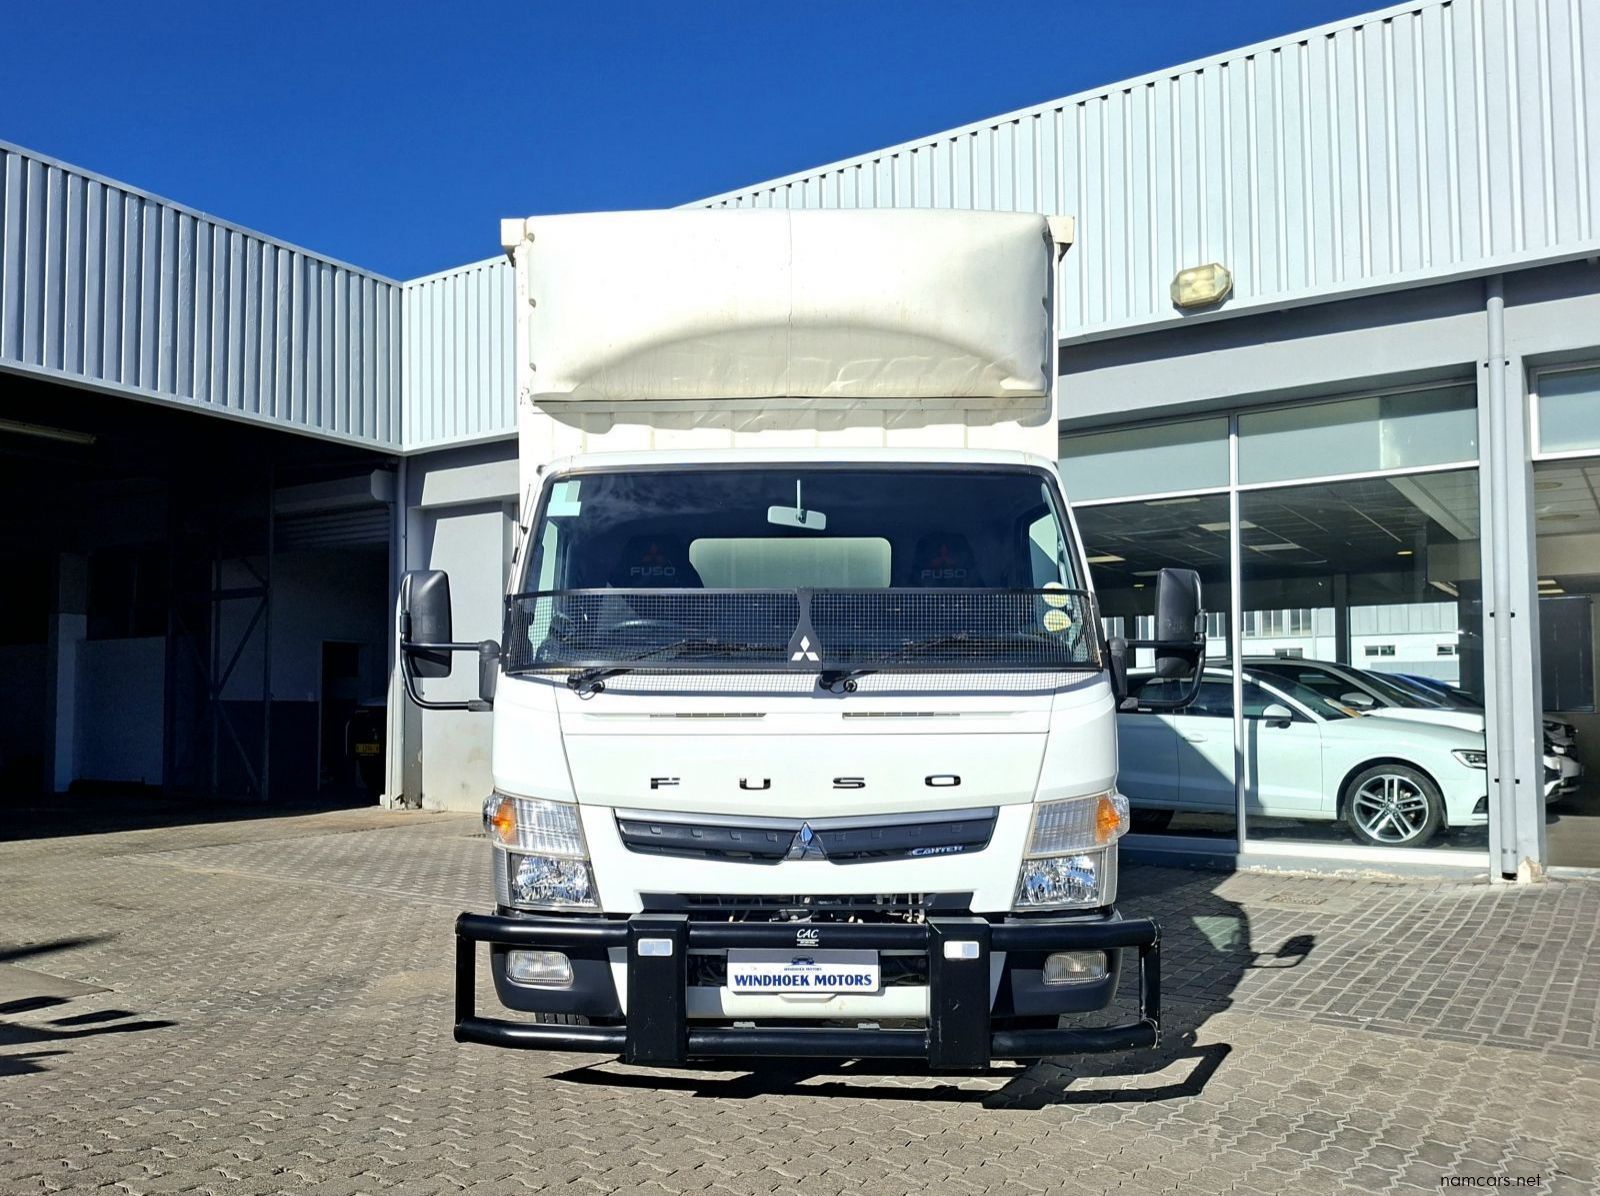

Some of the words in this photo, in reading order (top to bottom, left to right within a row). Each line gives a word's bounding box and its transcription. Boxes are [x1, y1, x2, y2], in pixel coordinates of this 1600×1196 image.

[630, 566, 676, 576] FUSO
[921, 568, 967, 579] FUSO
[650, 774, 961, 789] FUSO
[796, 929, 819, 938] CAC
[734, 974, 810, 987] WINDHOEK
[814, 974, 872, 986] MOTORS
